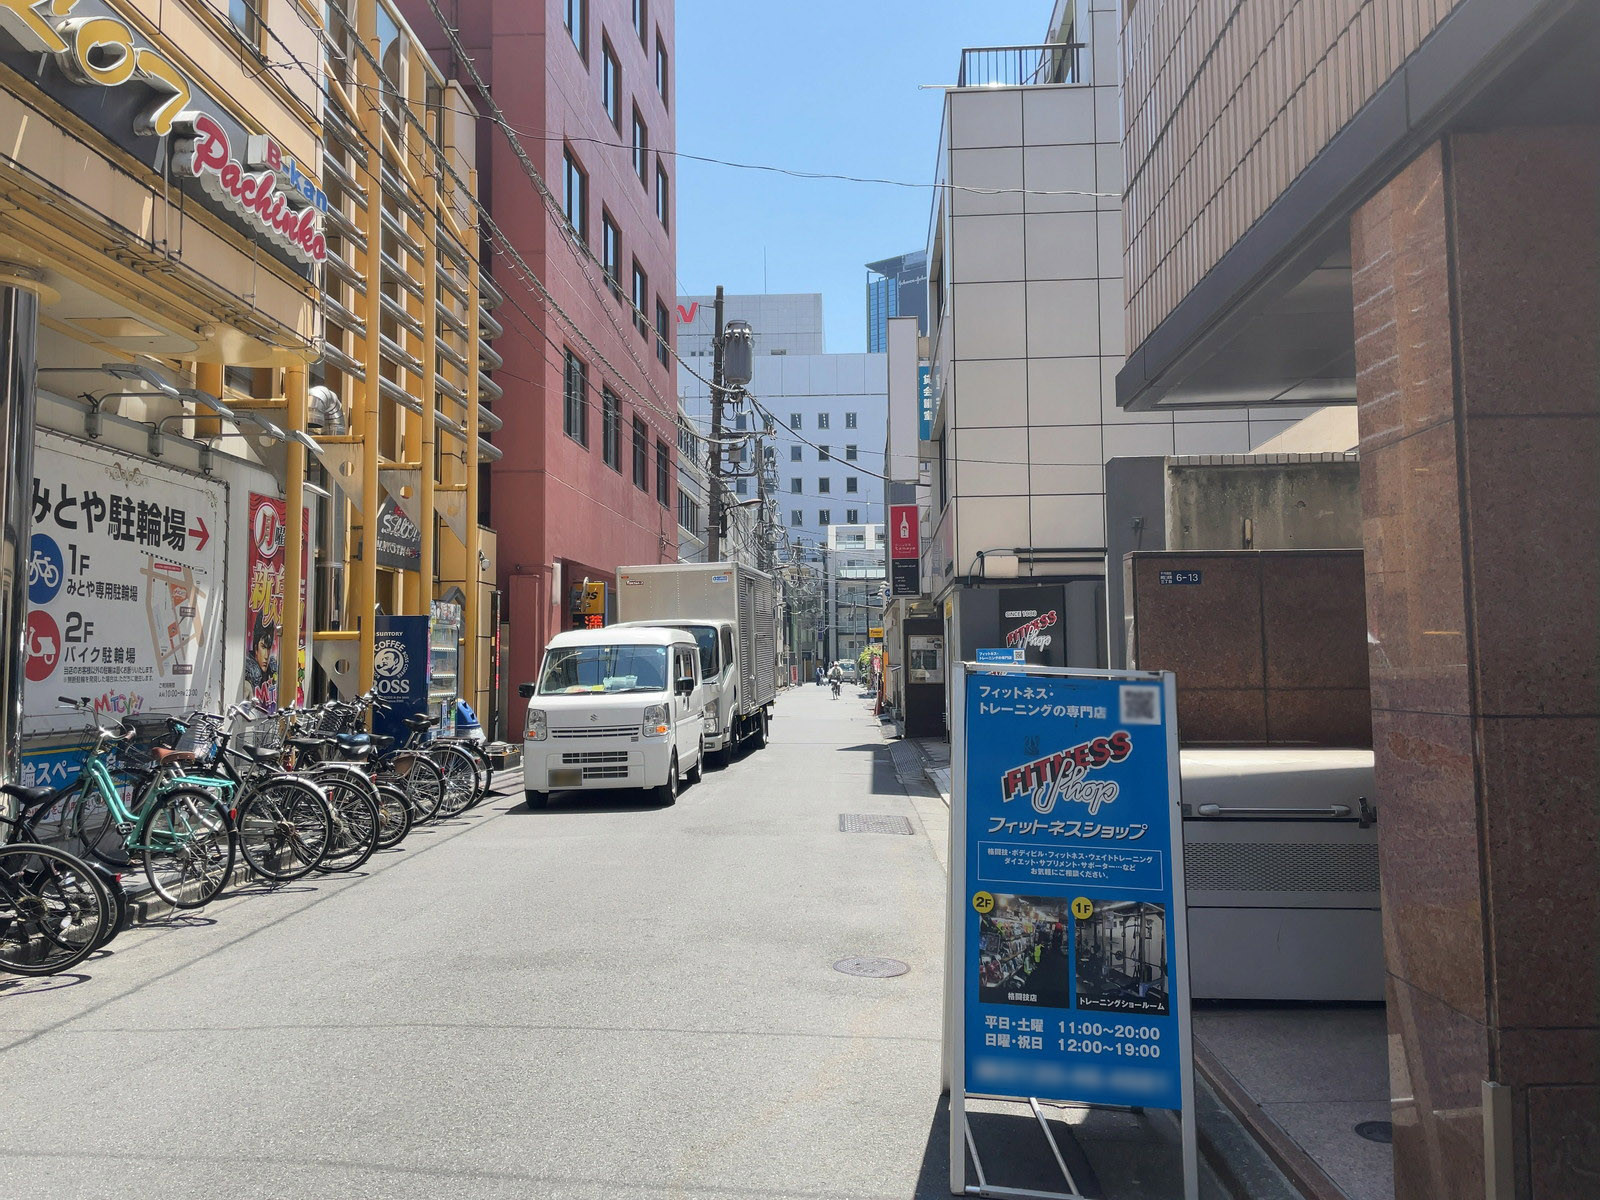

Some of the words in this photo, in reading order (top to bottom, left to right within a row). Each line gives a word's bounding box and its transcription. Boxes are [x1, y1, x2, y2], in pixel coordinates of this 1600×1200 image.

[267, 137, 328, 214] B-kan
[193, 115, 326, 261] Pachinko
[32, 477, 187, 551] みとや駐輪場
[68, 543, 90, 576] 1F
[1176, 573, 1199, 582] 6-13
[66, 578, 138, 602] みとや専用駐輪場
[64, 611, 94, 643] 2F
[1006, 610, 1057, 648] FITNESS
[64, 646, 137, 664] バイク駐輪場
[979, 702, 1107, 719] トレーニングの専門店
[1002, 731, 1132, 802] FITNESS
[1032, 758, 1120, 815] Shop
[988, 816, 1149, 841] フィットネスショップ
[1031, 868, 1108, 879] お気軽にご相談ください。
[976, 896, 992, 908] 2F
[1075, 902, 1091, 914] 1F
[1007, 992, 1037, 1002] 格闘技店
[1079, 997, 1165, 1010] トレーニングショールーム
[985, 1015, 1044, 1033] 平日・土曜
[985, 1033, 1043, 1050] 日曜・祝日
